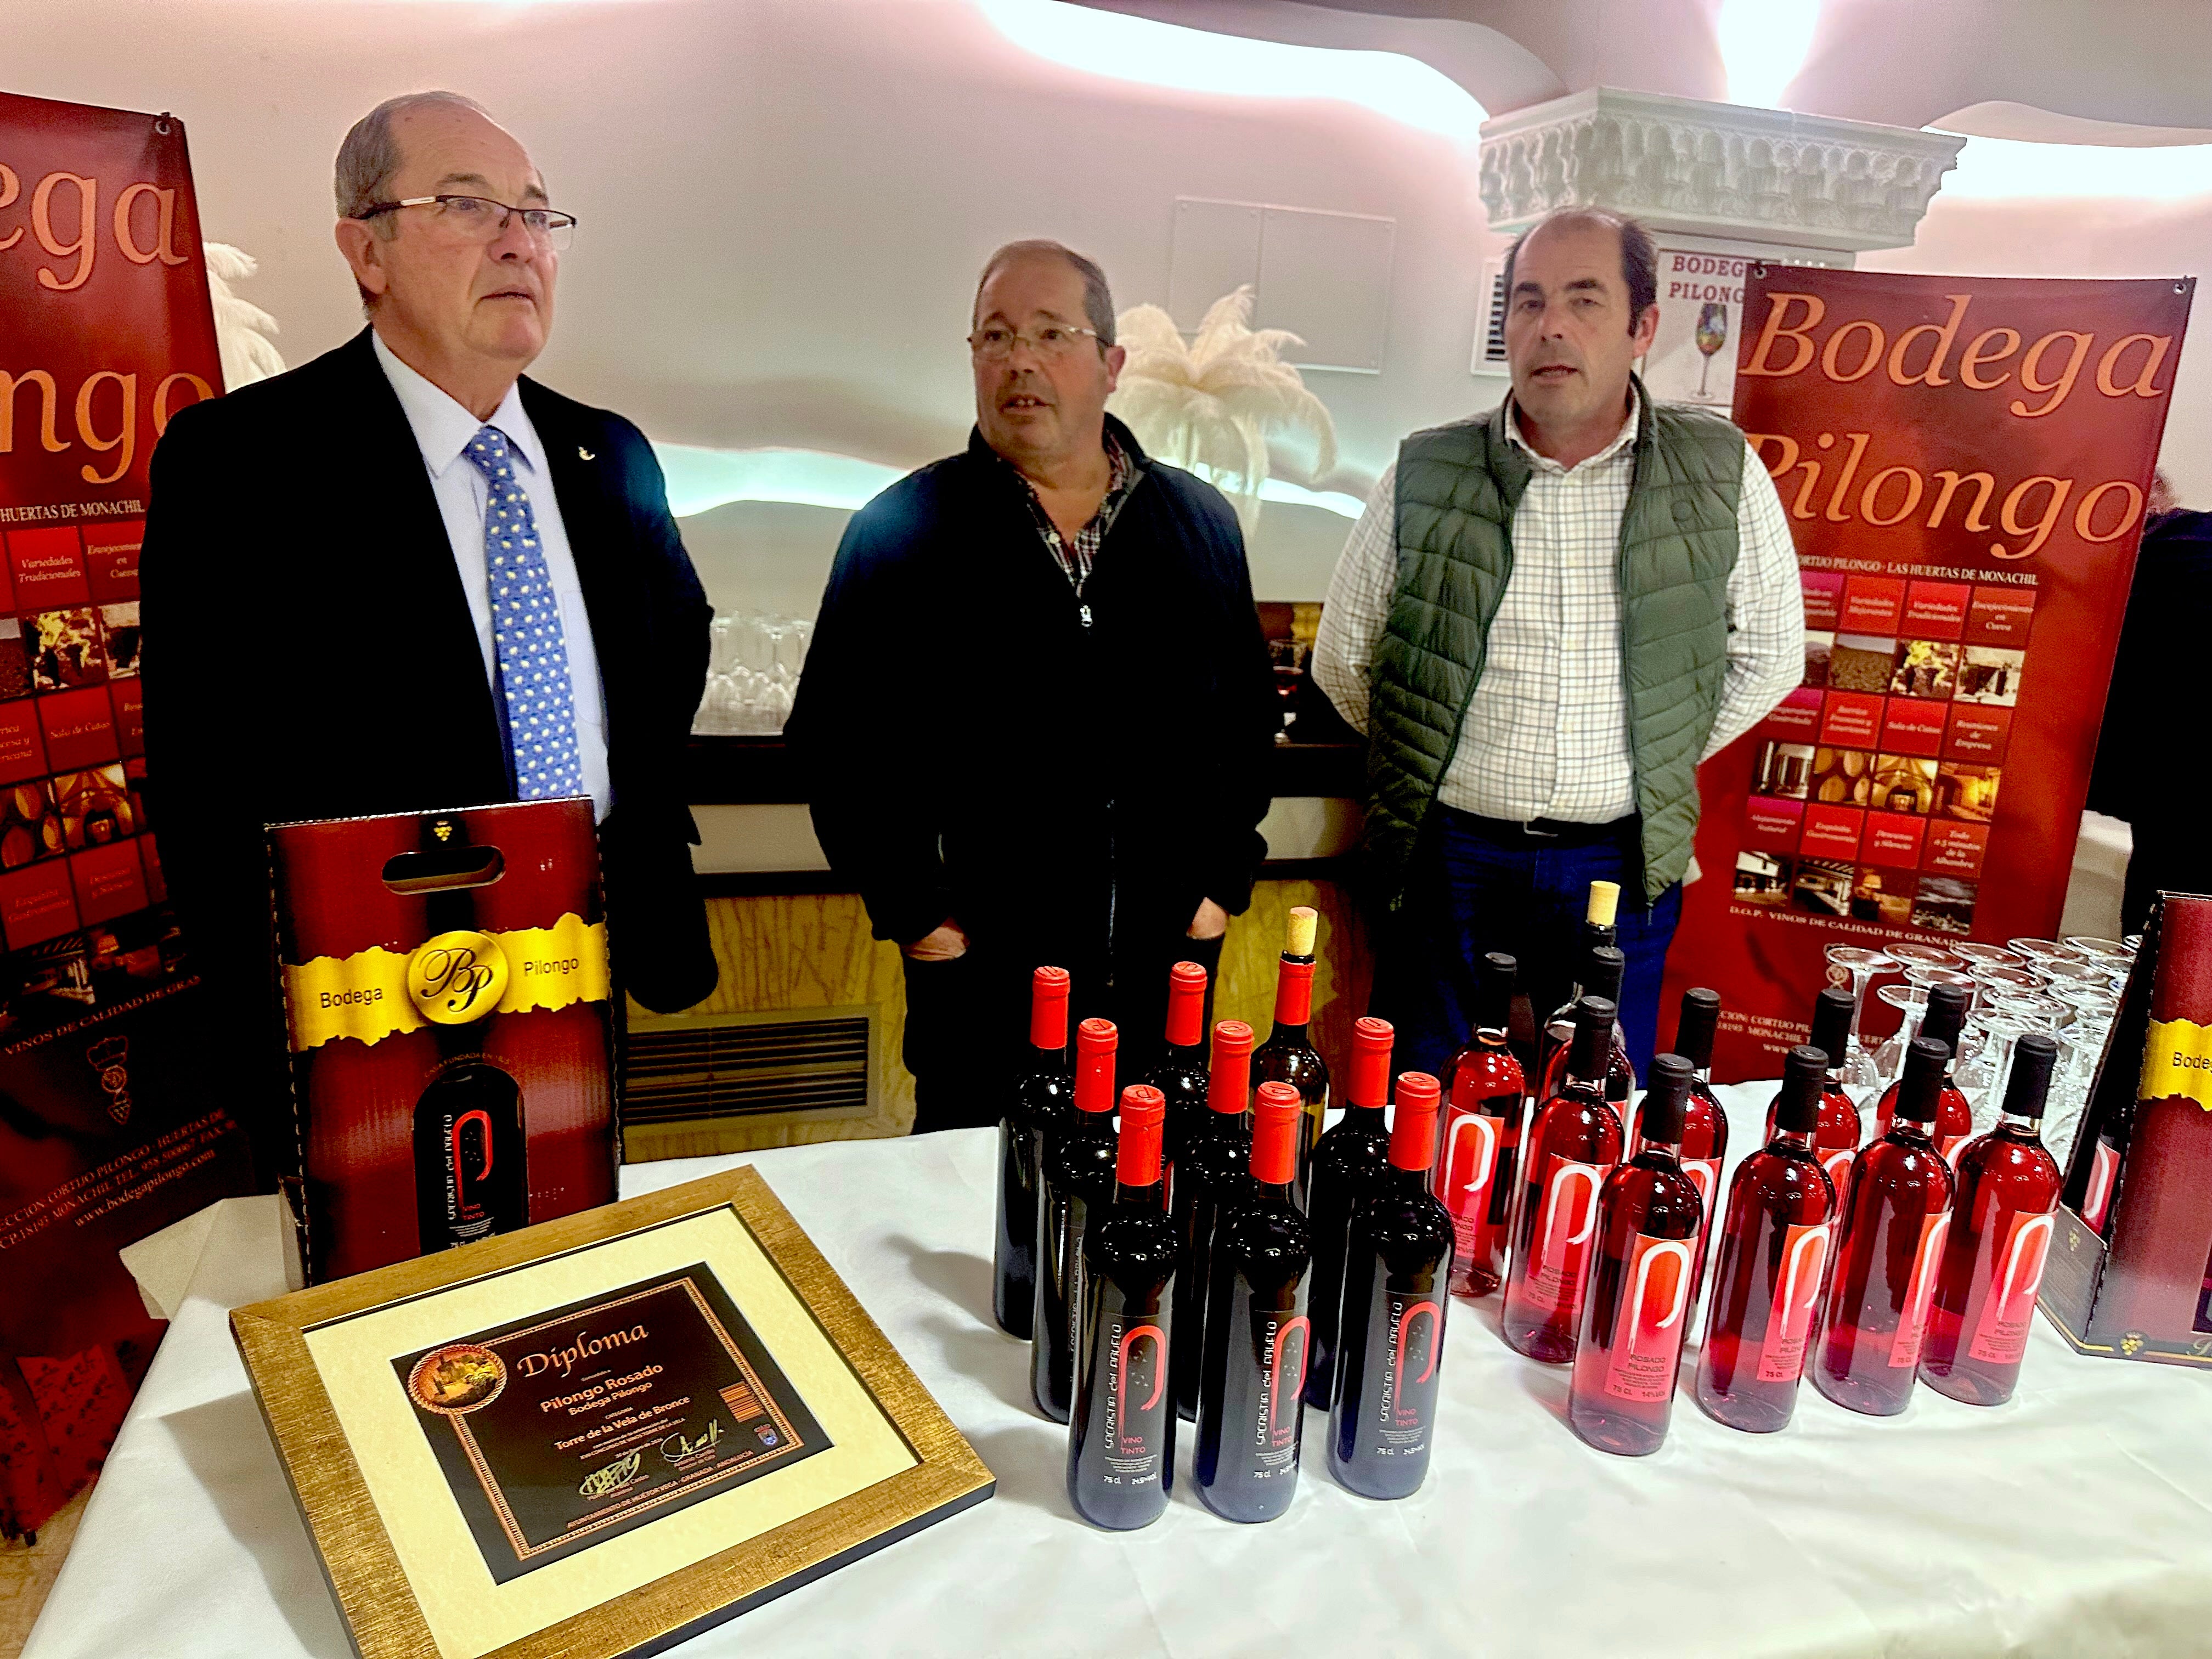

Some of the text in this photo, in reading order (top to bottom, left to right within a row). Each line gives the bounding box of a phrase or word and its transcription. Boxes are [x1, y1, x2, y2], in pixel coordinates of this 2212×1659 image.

[1673, 256, 1745, 277] BODEG
[1668, 281, 1745, 303] PILONG
[1738, 292, 2173, 417] Bodega
[1, 499, 145, 522] HUERTAS DE MONACHIL
[1833, 557, 1881, 573] PILONGO
[1887, 562, 1908, 575] LAS
[1909, 565, 1960, 579] HUERTAS
[1960, 568, 1977, 580] DE
[1978, 570, 2039, 586] MONACHIL
[1769, 911, 1807, 924] VINOS
[1809, 917, 1826, 927] DE
[1828, 921, 1883, 936] CALIDAD
[1885, 929, 1904, 939] DE
[1905, 932, 1959, 947] GRANAD
[524, 957, 580, 977] Pilongo
[320, 987, 383, 1009] Bodega
[4, 1031, 53, 1054] VINOS
[56, 1021, 79, 1036] DE
[80, 997, 143, 1027] CALIDAD
[1751, 1015, 1795, 1030] CORTIJO
[1747, 1025, 1803, 1044] MONACHIL
[2172, 1051, 2212, 1074] Bode
[48, 1171, 95, 1204] CORTIJO
[96, 1144, 150, 1178] PILONGO
[75, 1149, 216, 1227] www.bodegapilongo.com
[517, 1324, 649, 1378] Diploma
[1630, 1354, 1666, 1363] ROSADO
[1627, 1363, 1664, 1373] PILONGO
[540, 1386, 604, 1414] Pilongo
[604, 1365, 663, 1390] Rosado
[568, 1382, 653, 1416] Bodega Pilongo
[554, 1397, 691, 1451] Torre de la Vela de Bronce
[1273, 1426, 1291, 1436] VINO
[1121, 1446, 1146, 1454] TINTO
[1272, 1436, 1292, 1447] TINTO
